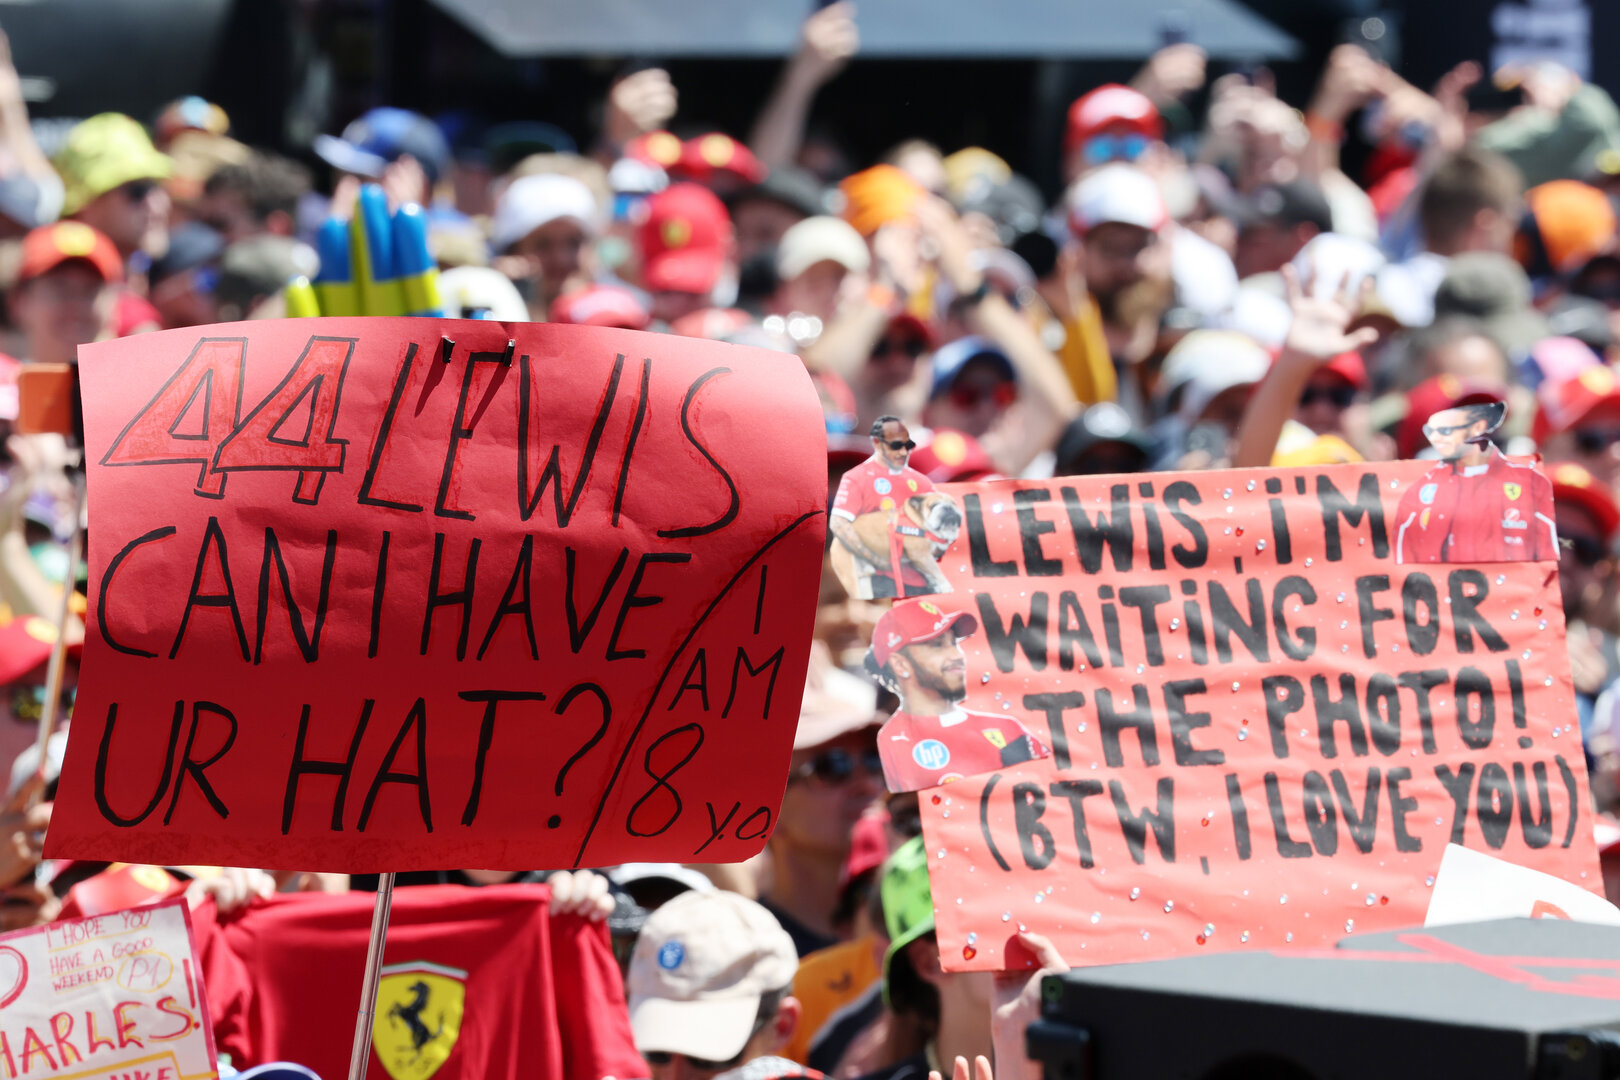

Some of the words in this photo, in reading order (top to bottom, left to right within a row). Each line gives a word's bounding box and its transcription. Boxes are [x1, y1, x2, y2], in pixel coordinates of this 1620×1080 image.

[99, 335, 359, 506] 44
[357, 342, 741, 538] LEWIS
[97, 516, 337, 665] CAN
[367, 530, 391, 659] I
[420, 532, 692, 662] HAVE
[753, 564, 768, 635] I
[1355, 568, 1510, 660] FOR
[666, 645, 785, 720] AM
[1022, 677, 1226, 770] THE
[1261, 659, 1533, 760] PHOTO!
[94, 699, 239, 828] UR
[281, 681, 613, 836] HAT?
[625, 722, 705, 837] 8
[1224, 772, 1252, 861] I
[1263, 765, 1423, 859] LOVE
[1433, 754, 1578, 850] YOU)
[44, 925, 52, 949] I
[62, 917, 106, 945] HOPE
[119, 908, 153, 930] YOU
[50, 951, 84, 976] HAVE
[93, 947, 105, 963] A
[111, 936, 154, 959] GOOD
[51, 965, 115, 992] WEEKEND
